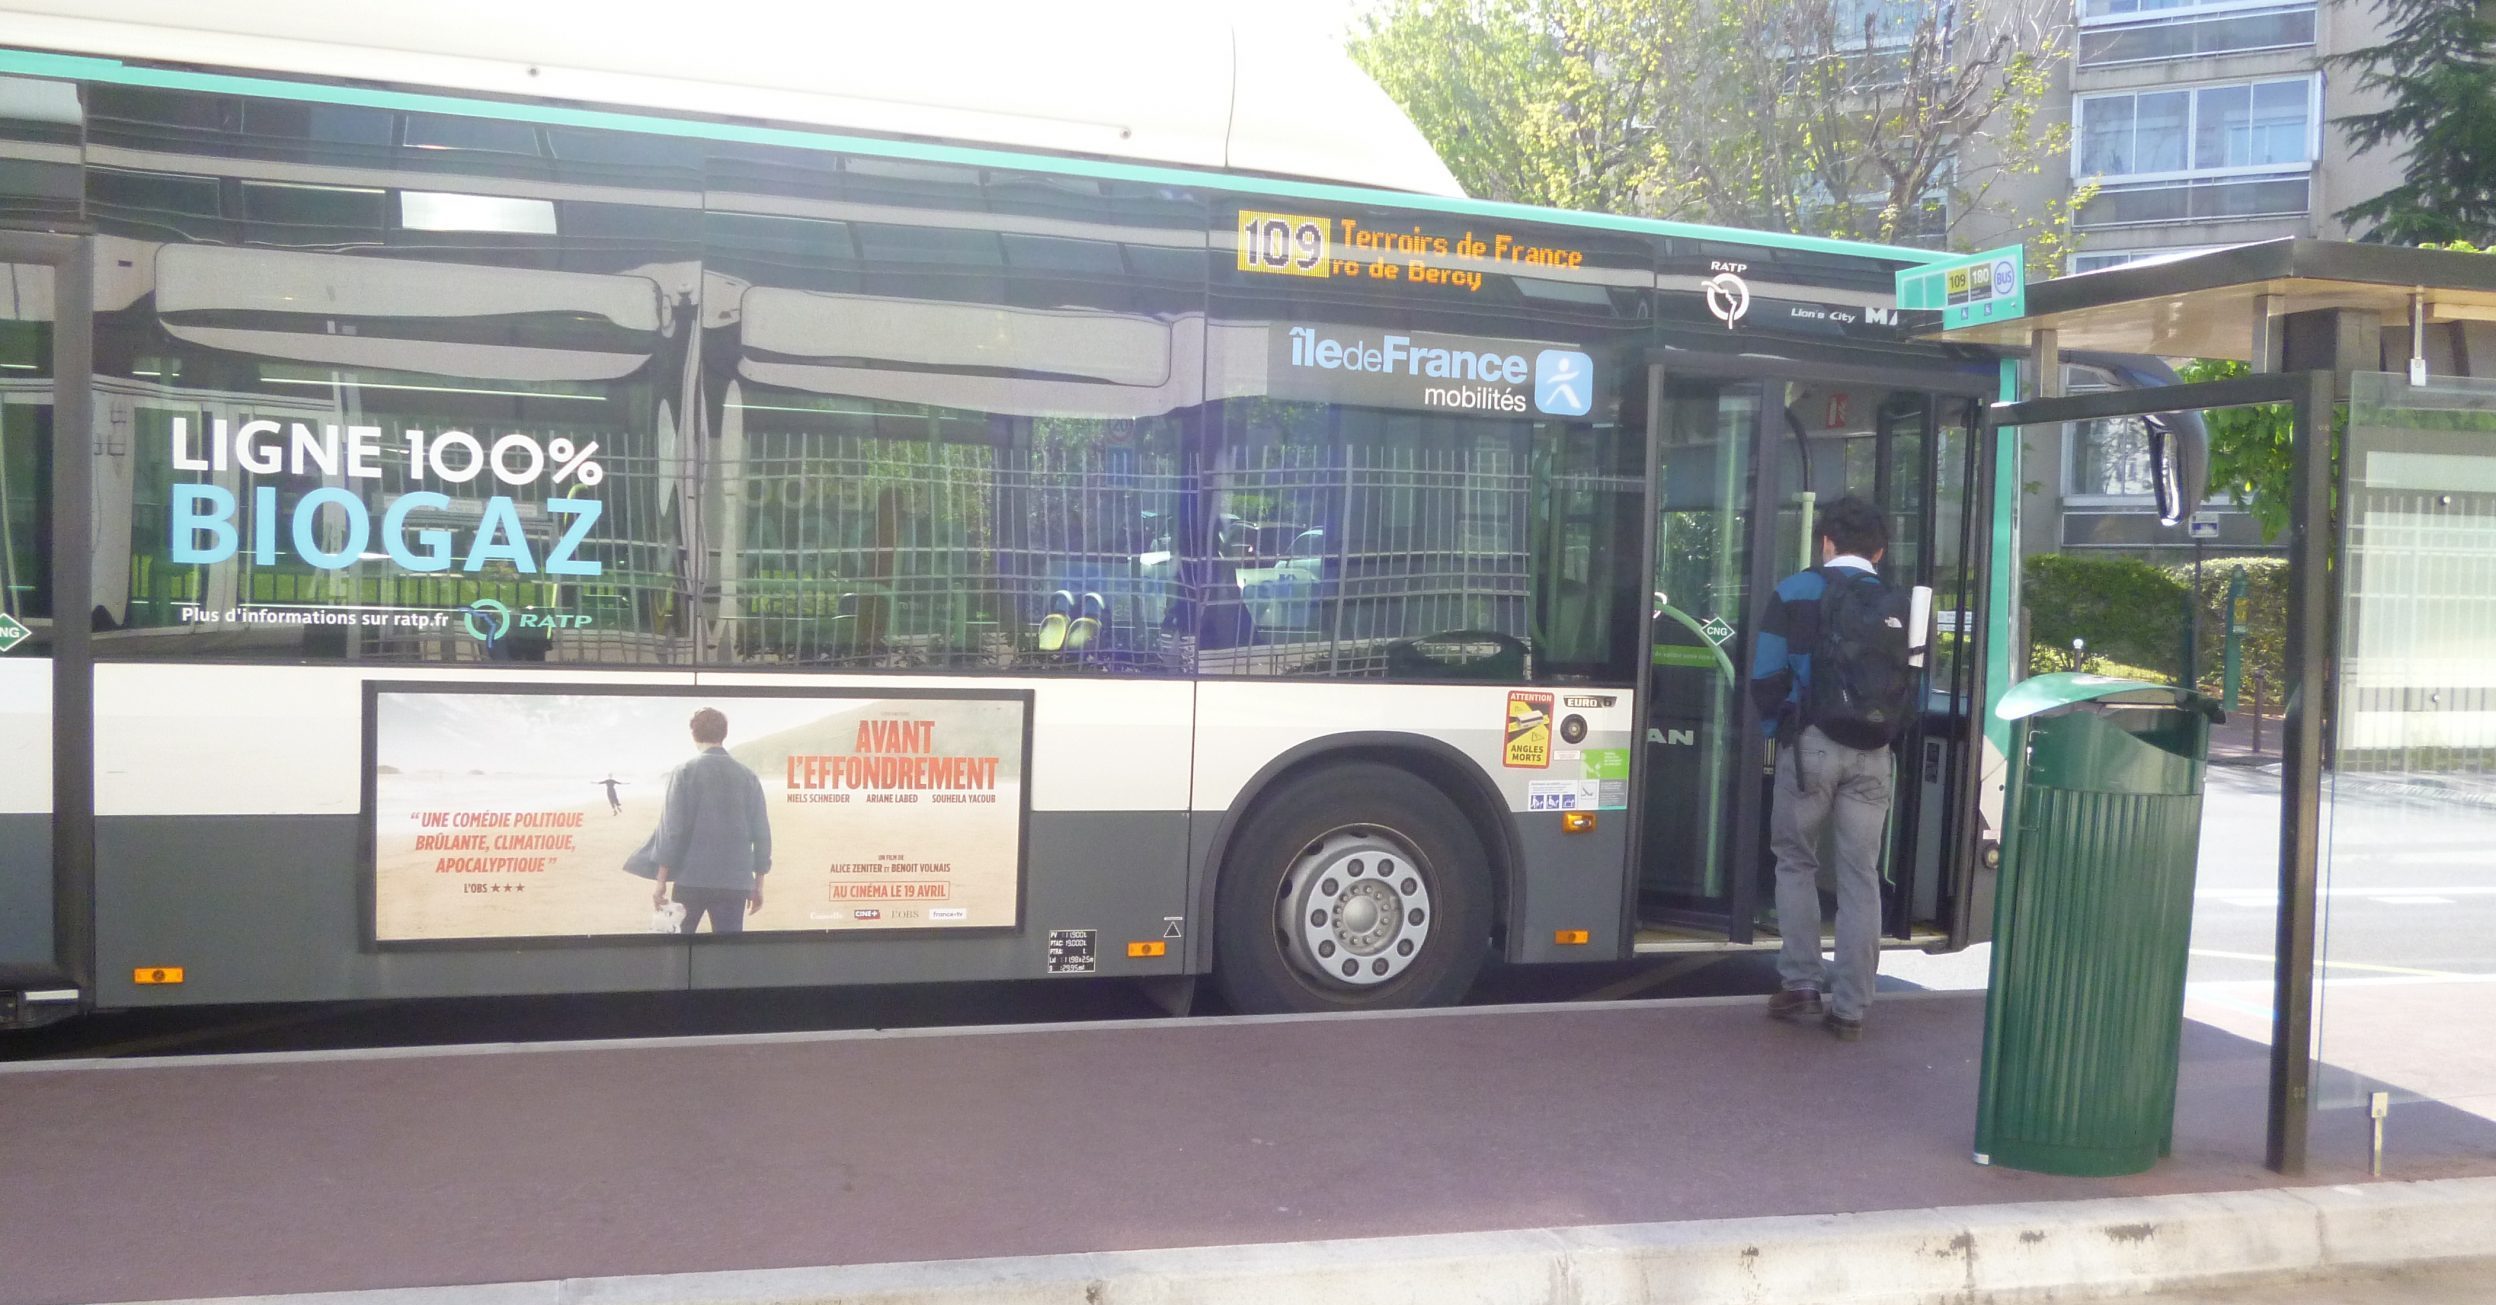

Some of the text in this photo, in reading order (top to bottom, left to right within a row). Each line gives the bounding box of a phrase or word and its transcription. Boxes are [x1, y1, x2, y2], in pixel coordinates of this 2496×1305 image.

[1244, 219, 1323, 270] 109
[1341, 219, 1583, 270] Terroirs de France
[1368, 257, 1399, 280] de
[1408, 259, 1483, 291] Bercy
[1711, 261, 1748, 273] RATP
[1950, 274, 1966, 289] 109
[1972, 268, 1989, 284] 180
[1996, 271, 2012, 285] BUS
[1790, 307, 1856, 323] Lion's City
[1424, 385, 1527, 412] mobilités
[172, 417, 604, 486] LIGNE 100%
[172, 483, 603, 576] BIOGAZ
[181, 607, 593, 631] Plus d'informations sur ratp.fr RATP
[0, 627, 20, 638] NG
[1706, 626, 1728, 636] CNG
[1510, 693, 1552, 702] ATTENTION
[1567, 698, 1598, 707] EURO
[855, 720, 935, 753] AVANT
[1648, 728, 1694, 746] AN
[1510, 744, 1544, 753] ANGLES
[1511, 753, 1542, 762] MORTS
[786, 755, 999, 790] L'EFFONDREMENT
[787, 793, 850, 803] NIELS SCHNEIDER
[866, 793, 918, 803] ARIANE LABED
[932, 793, 996, 803] SOUHEILA YACOUB
[452, 810, 511, 828] COMÉDIE
[513, 812, 584, 828] POLITIQUE
[415, 832, 576, 852] BRÛLANTE, CLIMATIQUE,
[830, 864, 850, 873] ALICE
[852, 864, 882, 873] ZENITER
[891, 863, 918, 873] BENOIT
[920, 863, 951, 873] VOLNAIS
[464, 884, 488, 894] L'OBS
[833, 883, 946, 898] AU CINÉMA LE 19 AVRIL
